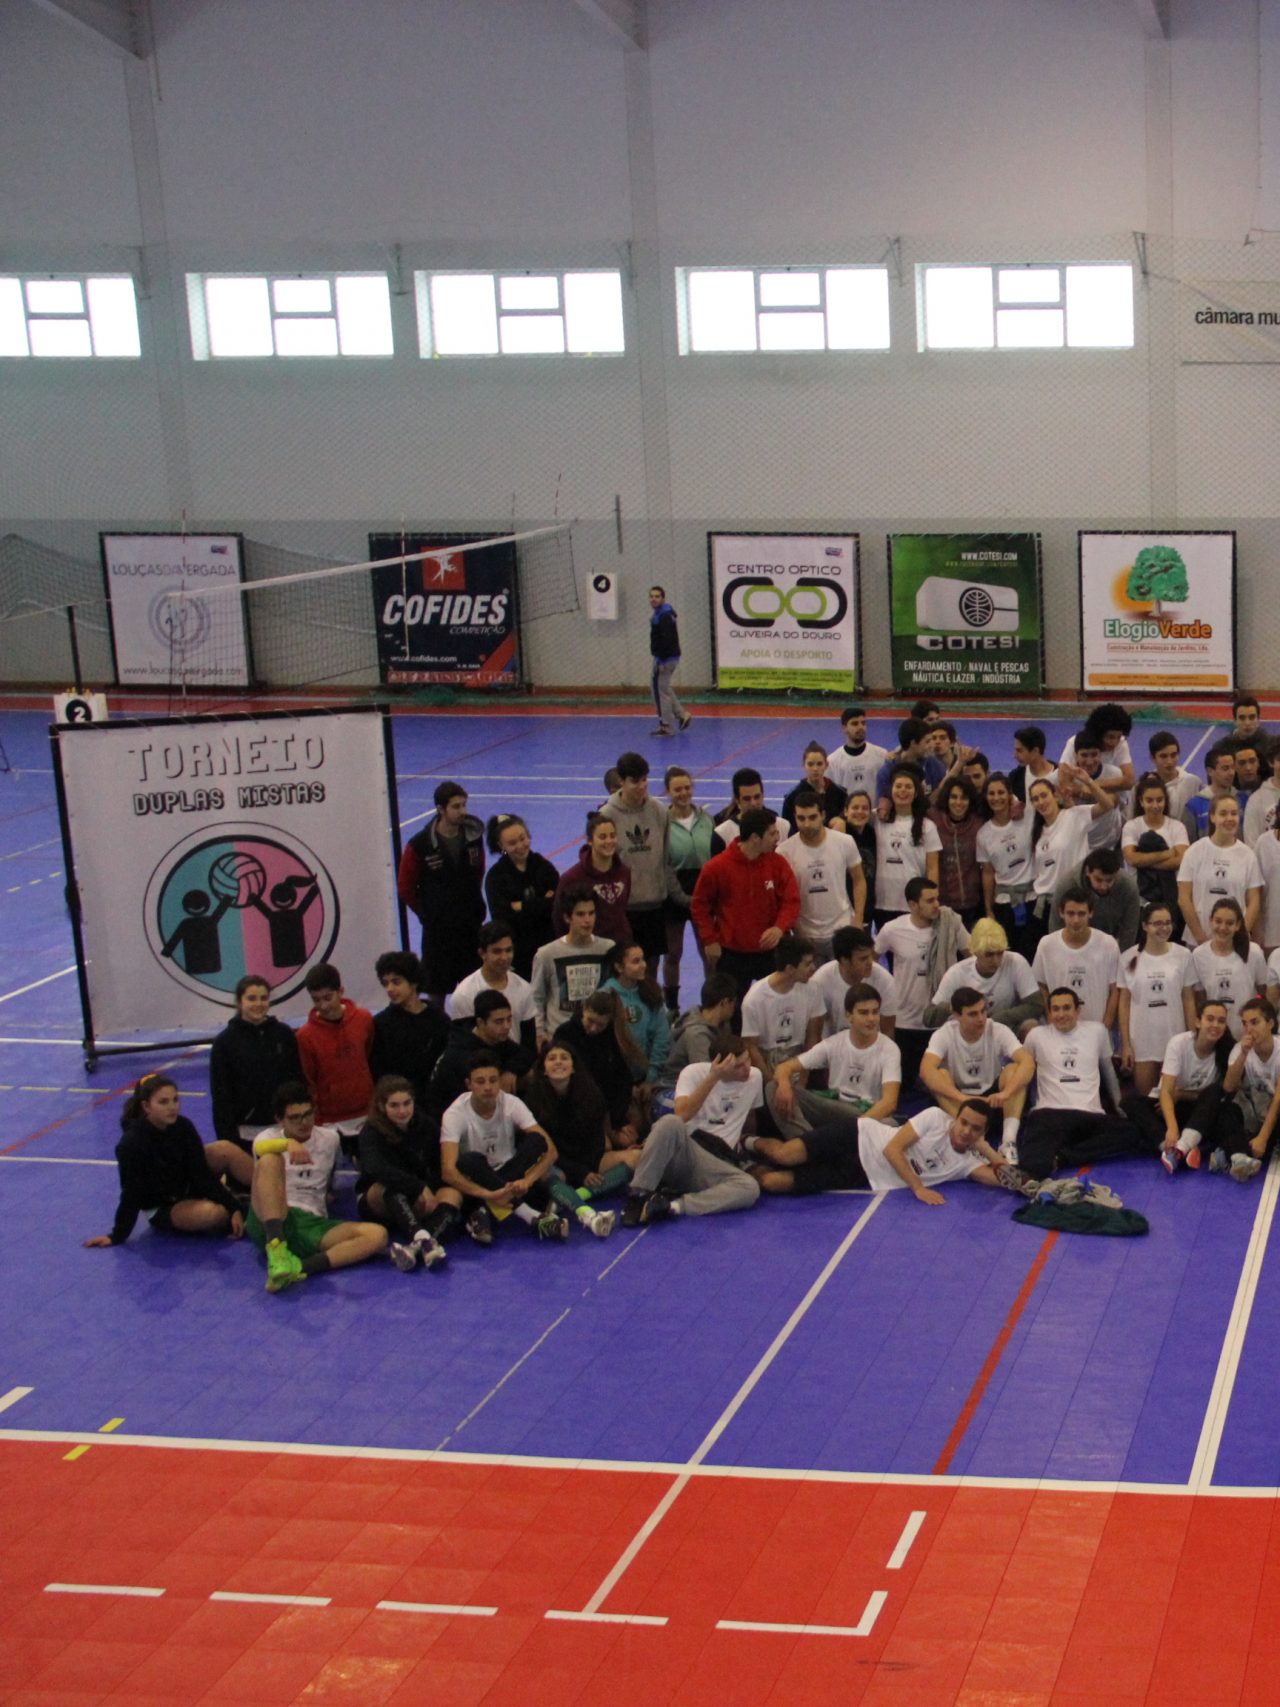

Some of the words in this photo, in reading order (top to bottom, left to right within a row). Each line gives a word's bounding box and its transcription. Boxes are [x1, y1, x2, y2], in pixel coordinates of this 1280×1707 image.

[1195, 307, 1255, 325] câmara
[961, 552, 1018, 561] WWW.COTESI.COM
[727, 564, 785, 575] CENTRO
[788, 565, 842, 576] OPTICO
[382, 594, 509, 626] COFIDES
[729, 630, 781, 639] OLIVEIRA
[783, 631, 799, 640] DO
[802, 632, 842, 641] DOURO
[1103, 619, 1213, 643] ElogioVerde
[919, 635, 1020, 650] COTESI
[904, 660, 961, 671] ENFARDAMENTO
[969, 661, 992, 673] NAVAL
[1001, 662, 1030, 673] PESCAS
[912, 670, 944, 683] NÁUTICA
[953, 672, 975, 683] LAZER
[74, 706, 86, 722] 2
[128, 734, 324, 782] TORNEIO
[133, 788, 224, 816] DUPLAS
[238, 782, 326, 808] MISTAS
